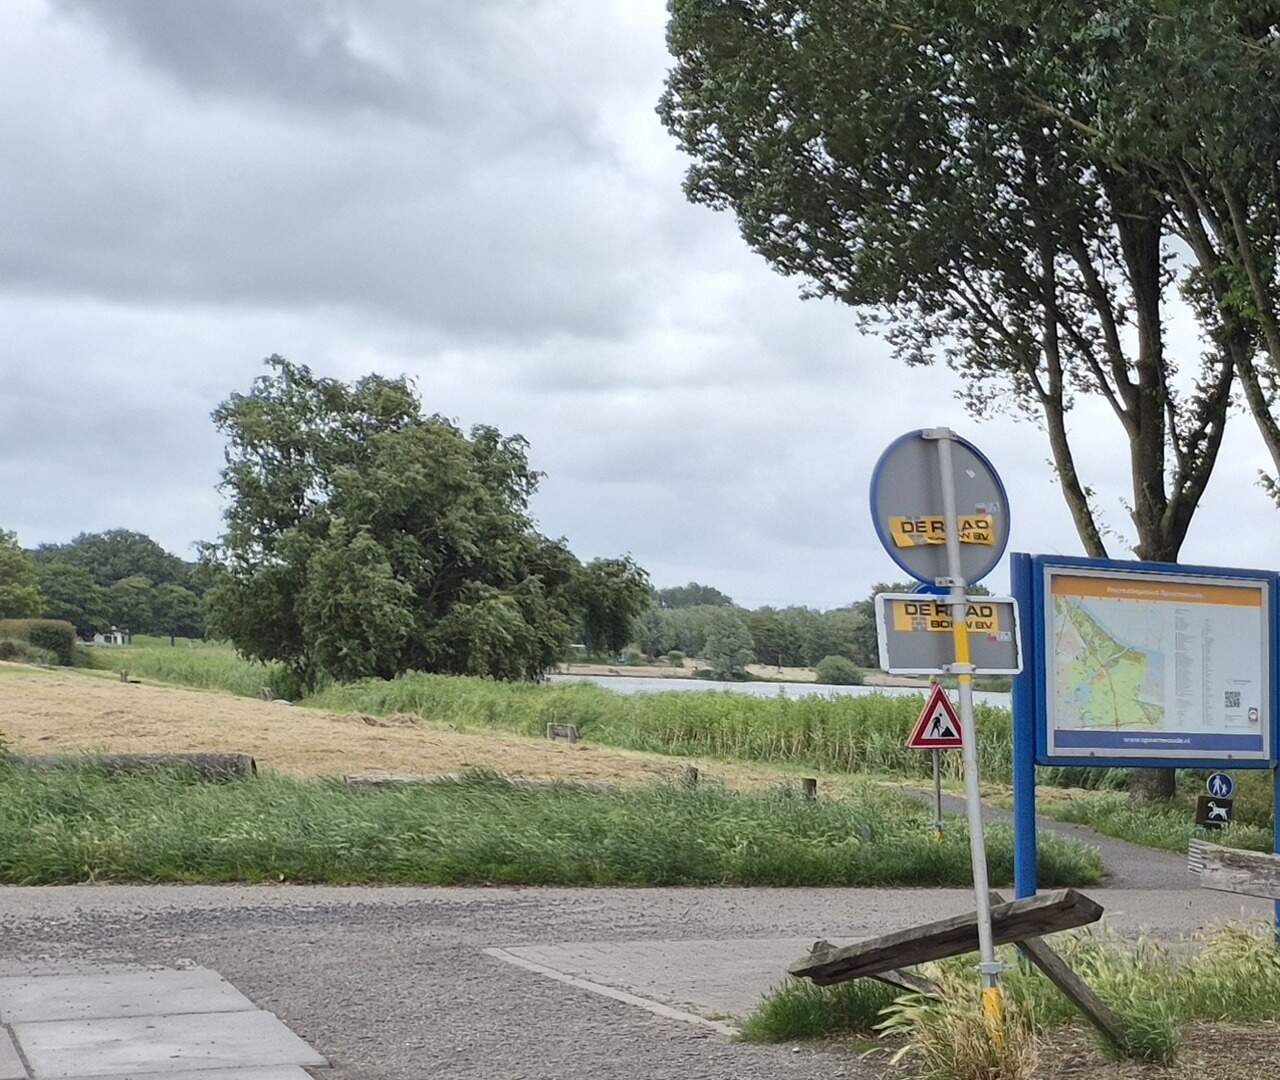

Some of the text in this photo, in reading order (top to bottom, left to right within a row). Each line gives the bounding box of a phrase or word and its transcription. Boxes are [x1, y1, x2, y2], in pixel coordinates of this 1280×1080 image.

[901, 519, 990, 533] DE RAD
[905, 603, 993, 618] DE RAD
